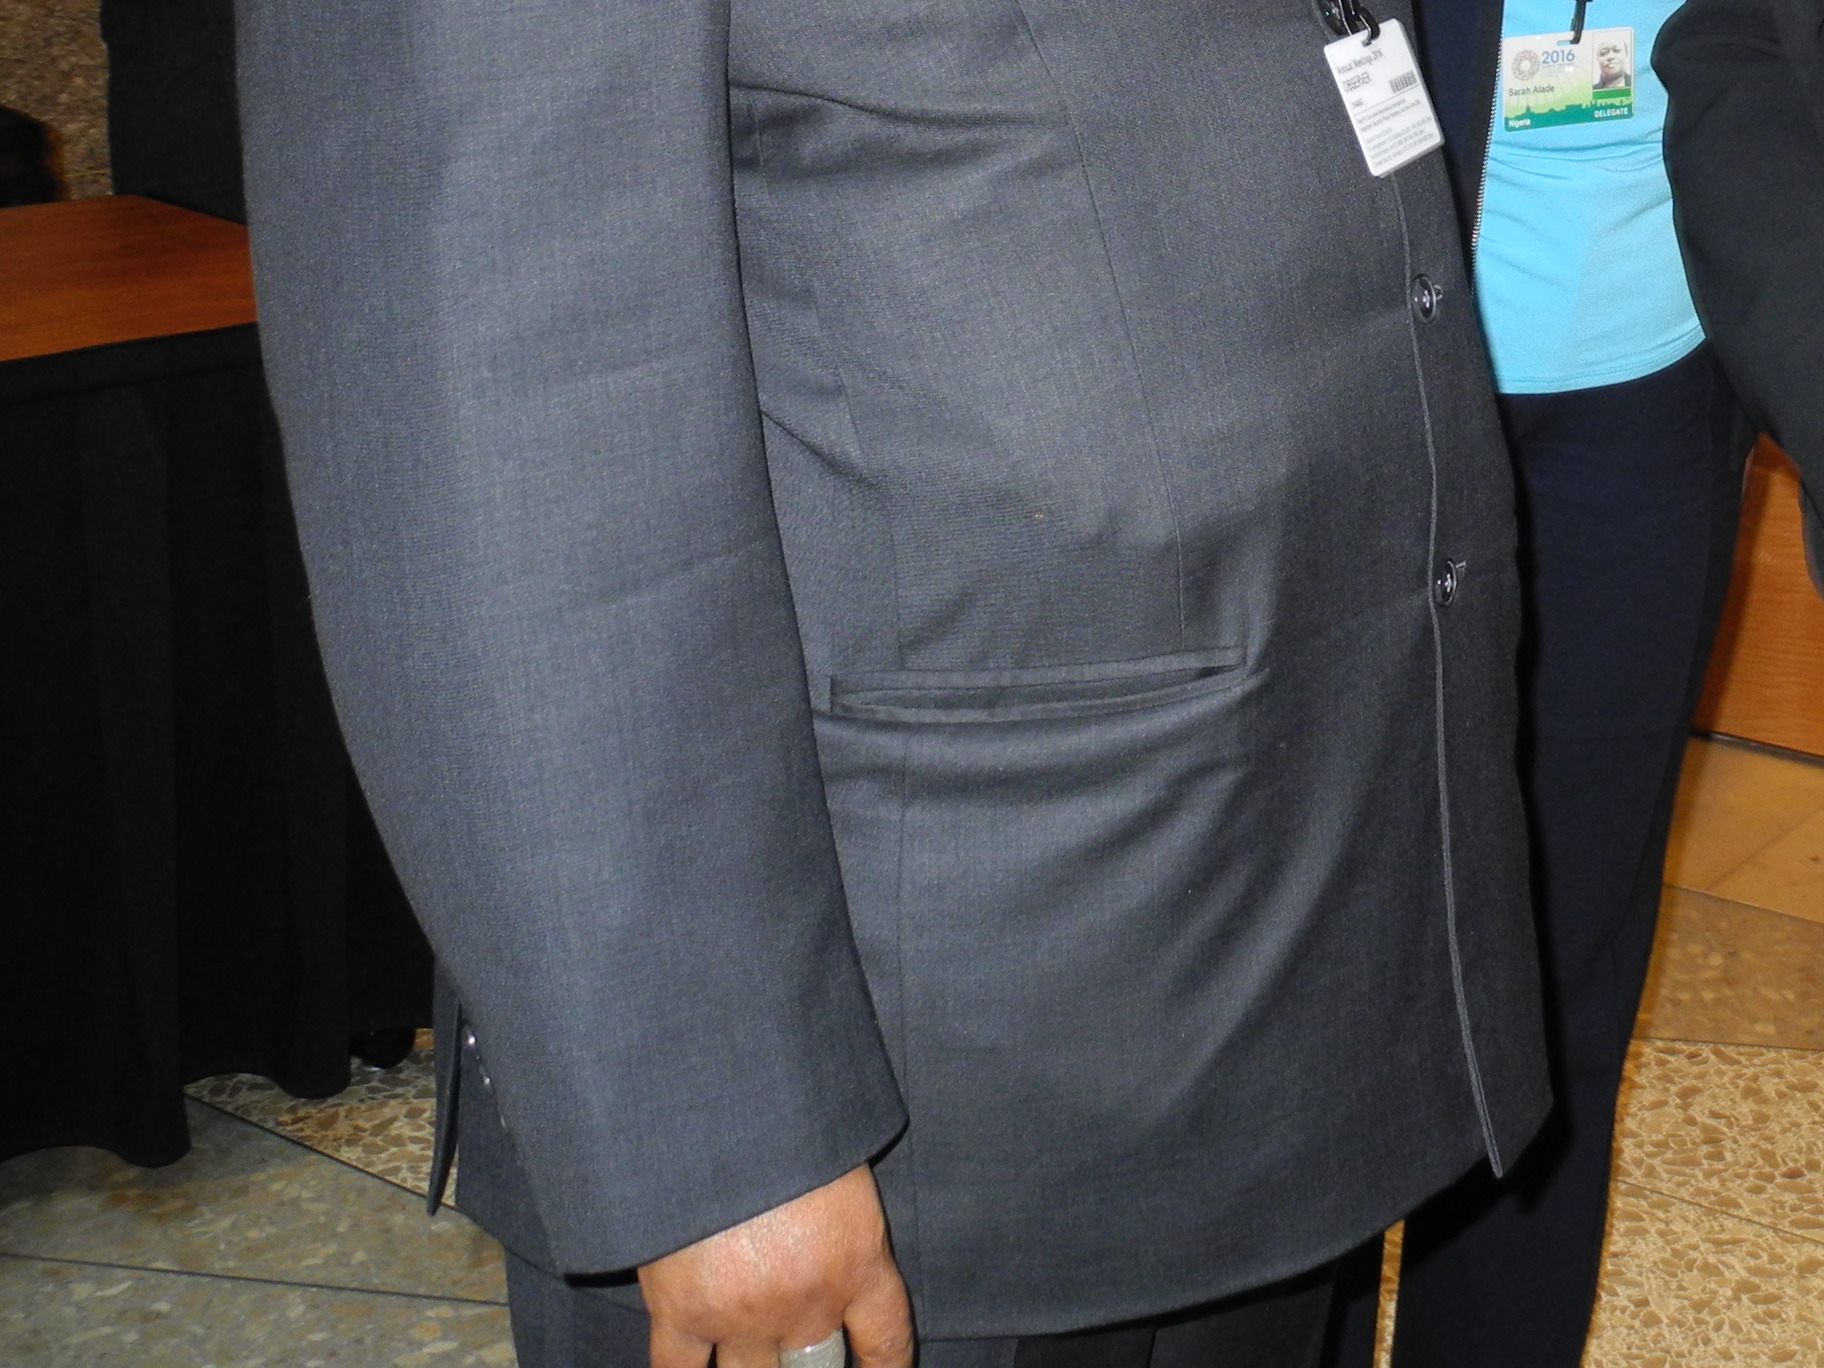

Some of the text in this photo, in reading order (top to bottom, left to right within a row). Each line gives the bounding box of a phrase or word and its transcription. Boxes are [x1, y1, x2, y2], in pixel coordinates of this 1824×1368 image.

[1541, 49, 1576, 65] 2016
[1508, 84, 1555, 97] Sarah Alade
[1594, 107, 1629, 118] DELEGATE
